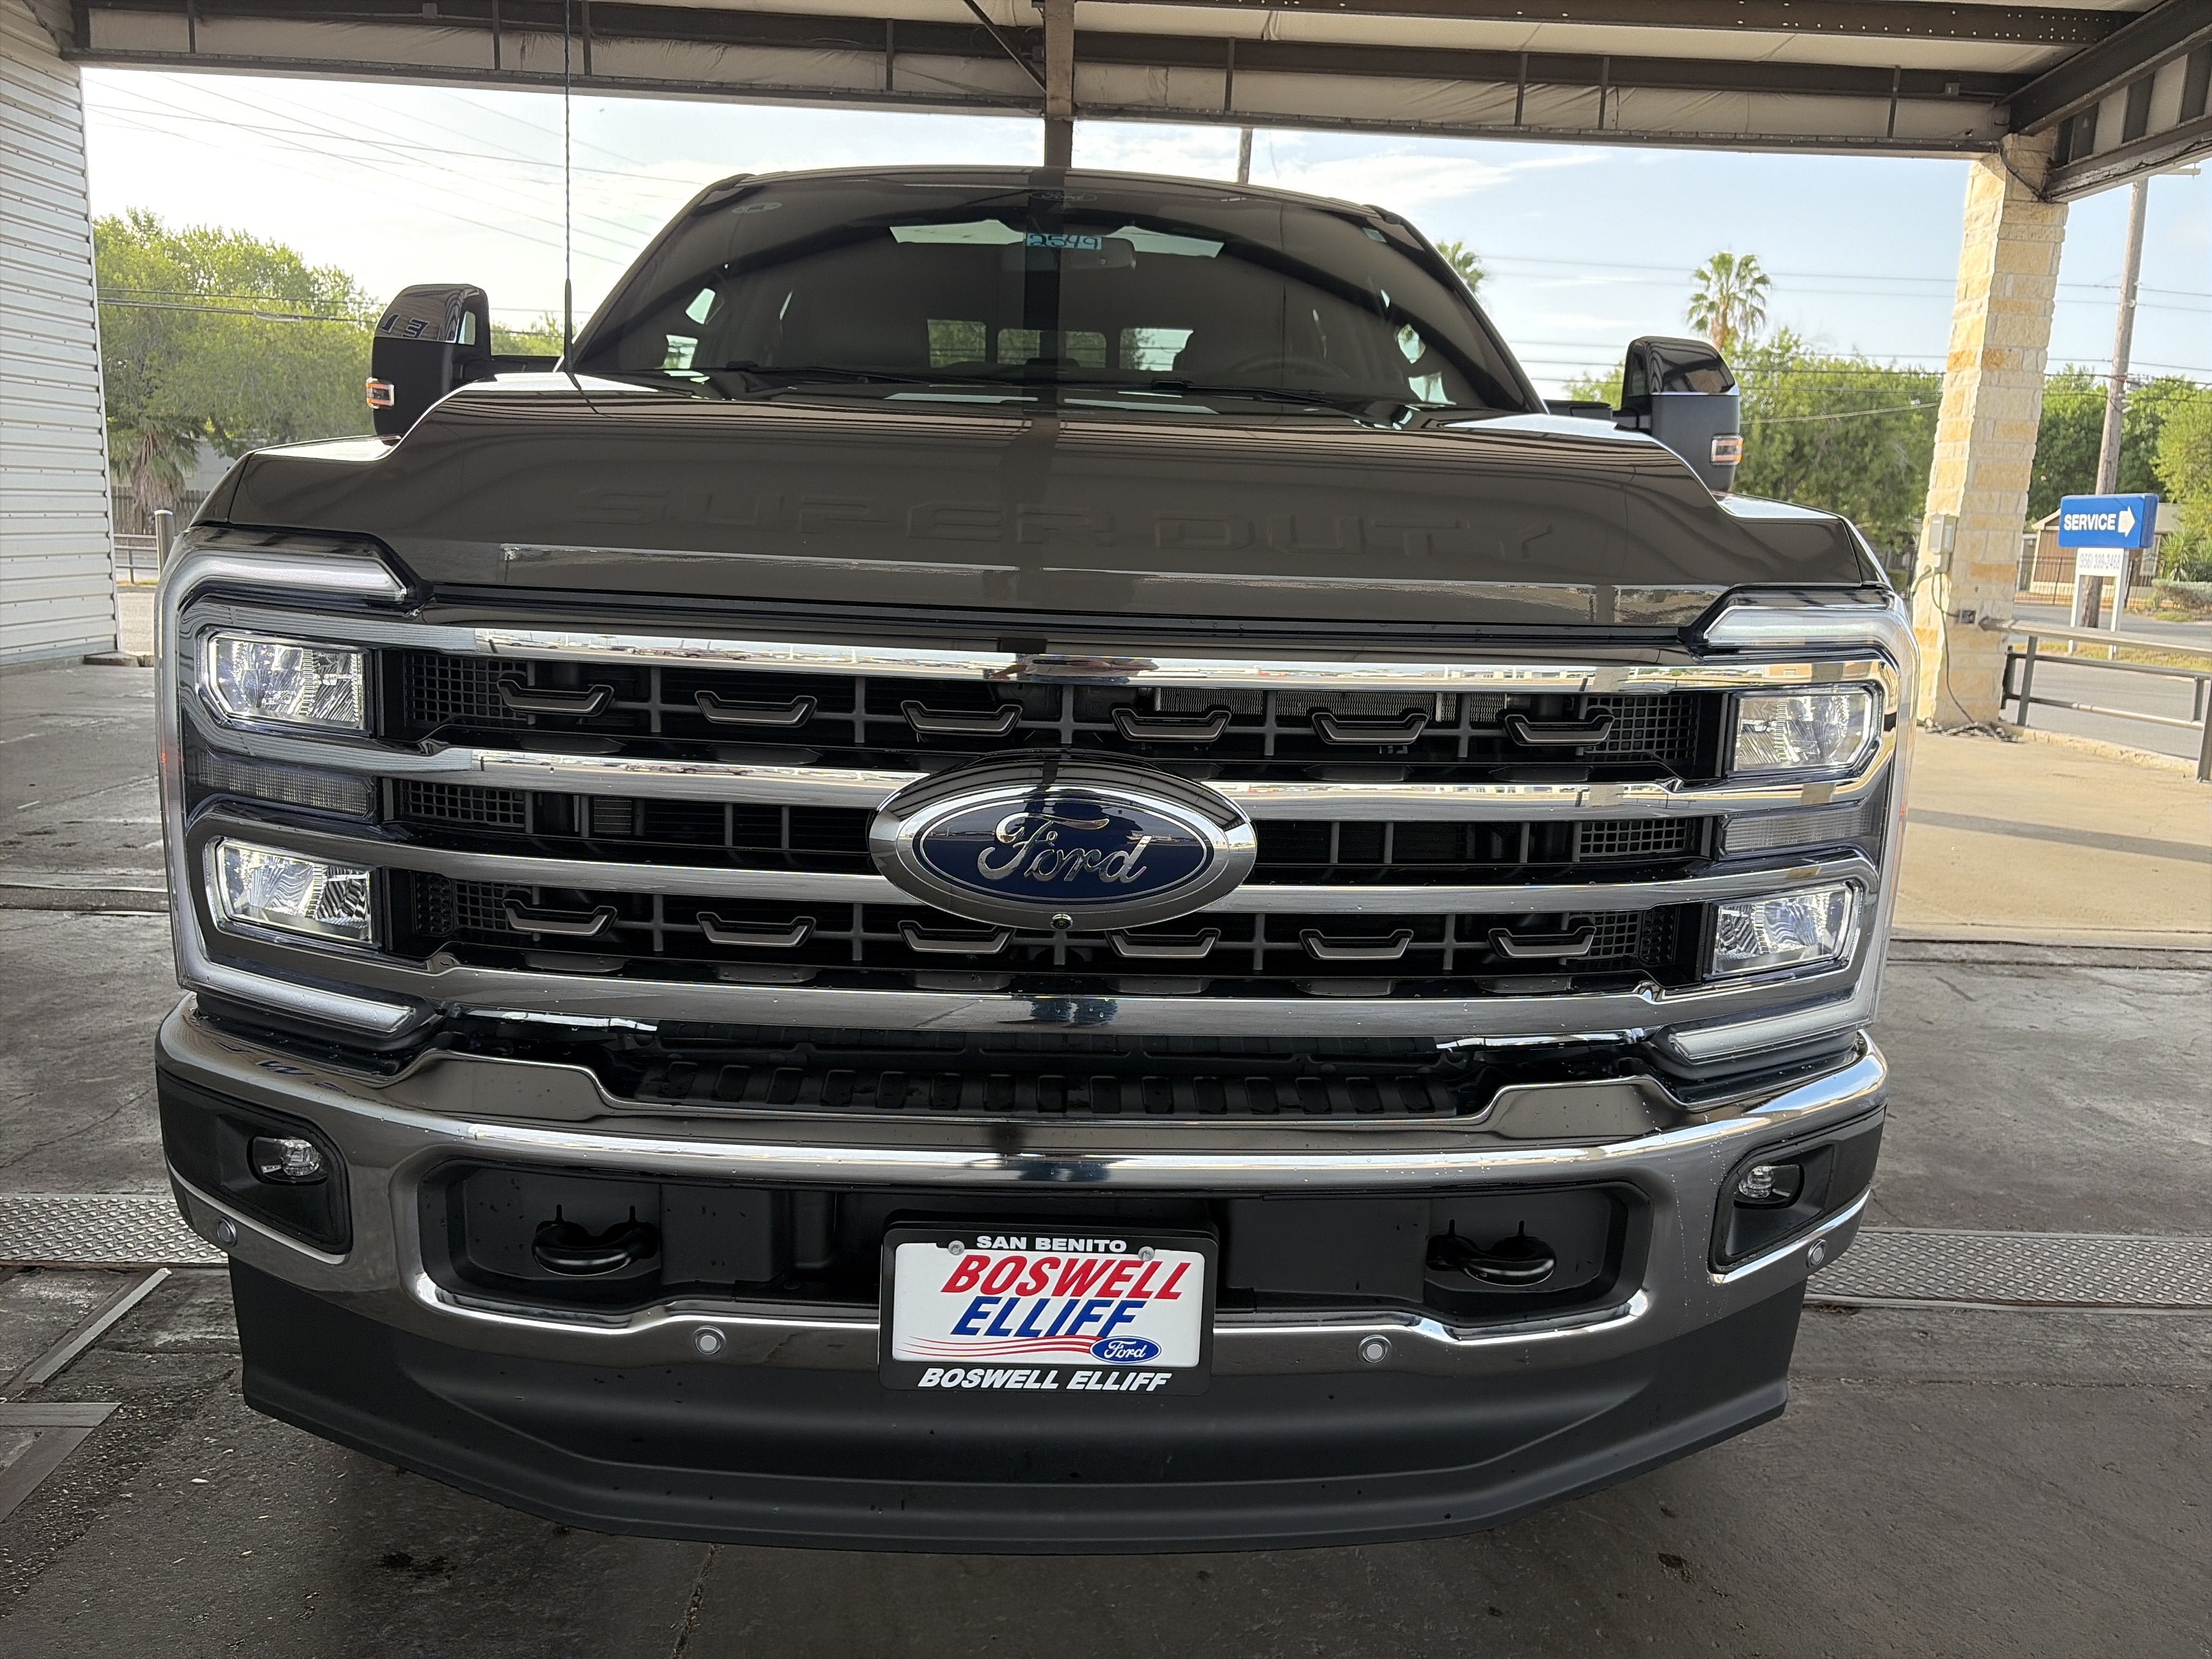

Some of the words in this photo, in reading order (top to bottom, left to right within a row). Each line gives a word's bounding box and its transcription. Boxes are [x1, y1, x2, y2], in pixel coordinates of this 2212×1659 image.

[1029, 234, 1098, 250] 2549
[572, 487, 1116, 548] SUPER
[1154, 510, 1553, 560] DUTY
[2063, 514, 2117, 531] SERVICE
[977, 812, 1152, 882] Ford
[977, 1235, 1027, 1250] SAN
[1035, 1238, 1127, 1253] BENITO
[940, 1254, 1192, 1300] BOSWELL
[950, 1296, 1148, 1338] ELLIFF
[1104, 1340, 1147, 1359] Ford
[918, 1368, 1059, 1389] BOSWELL
[1066, 1370, 1172, 1391] ELLIFF
